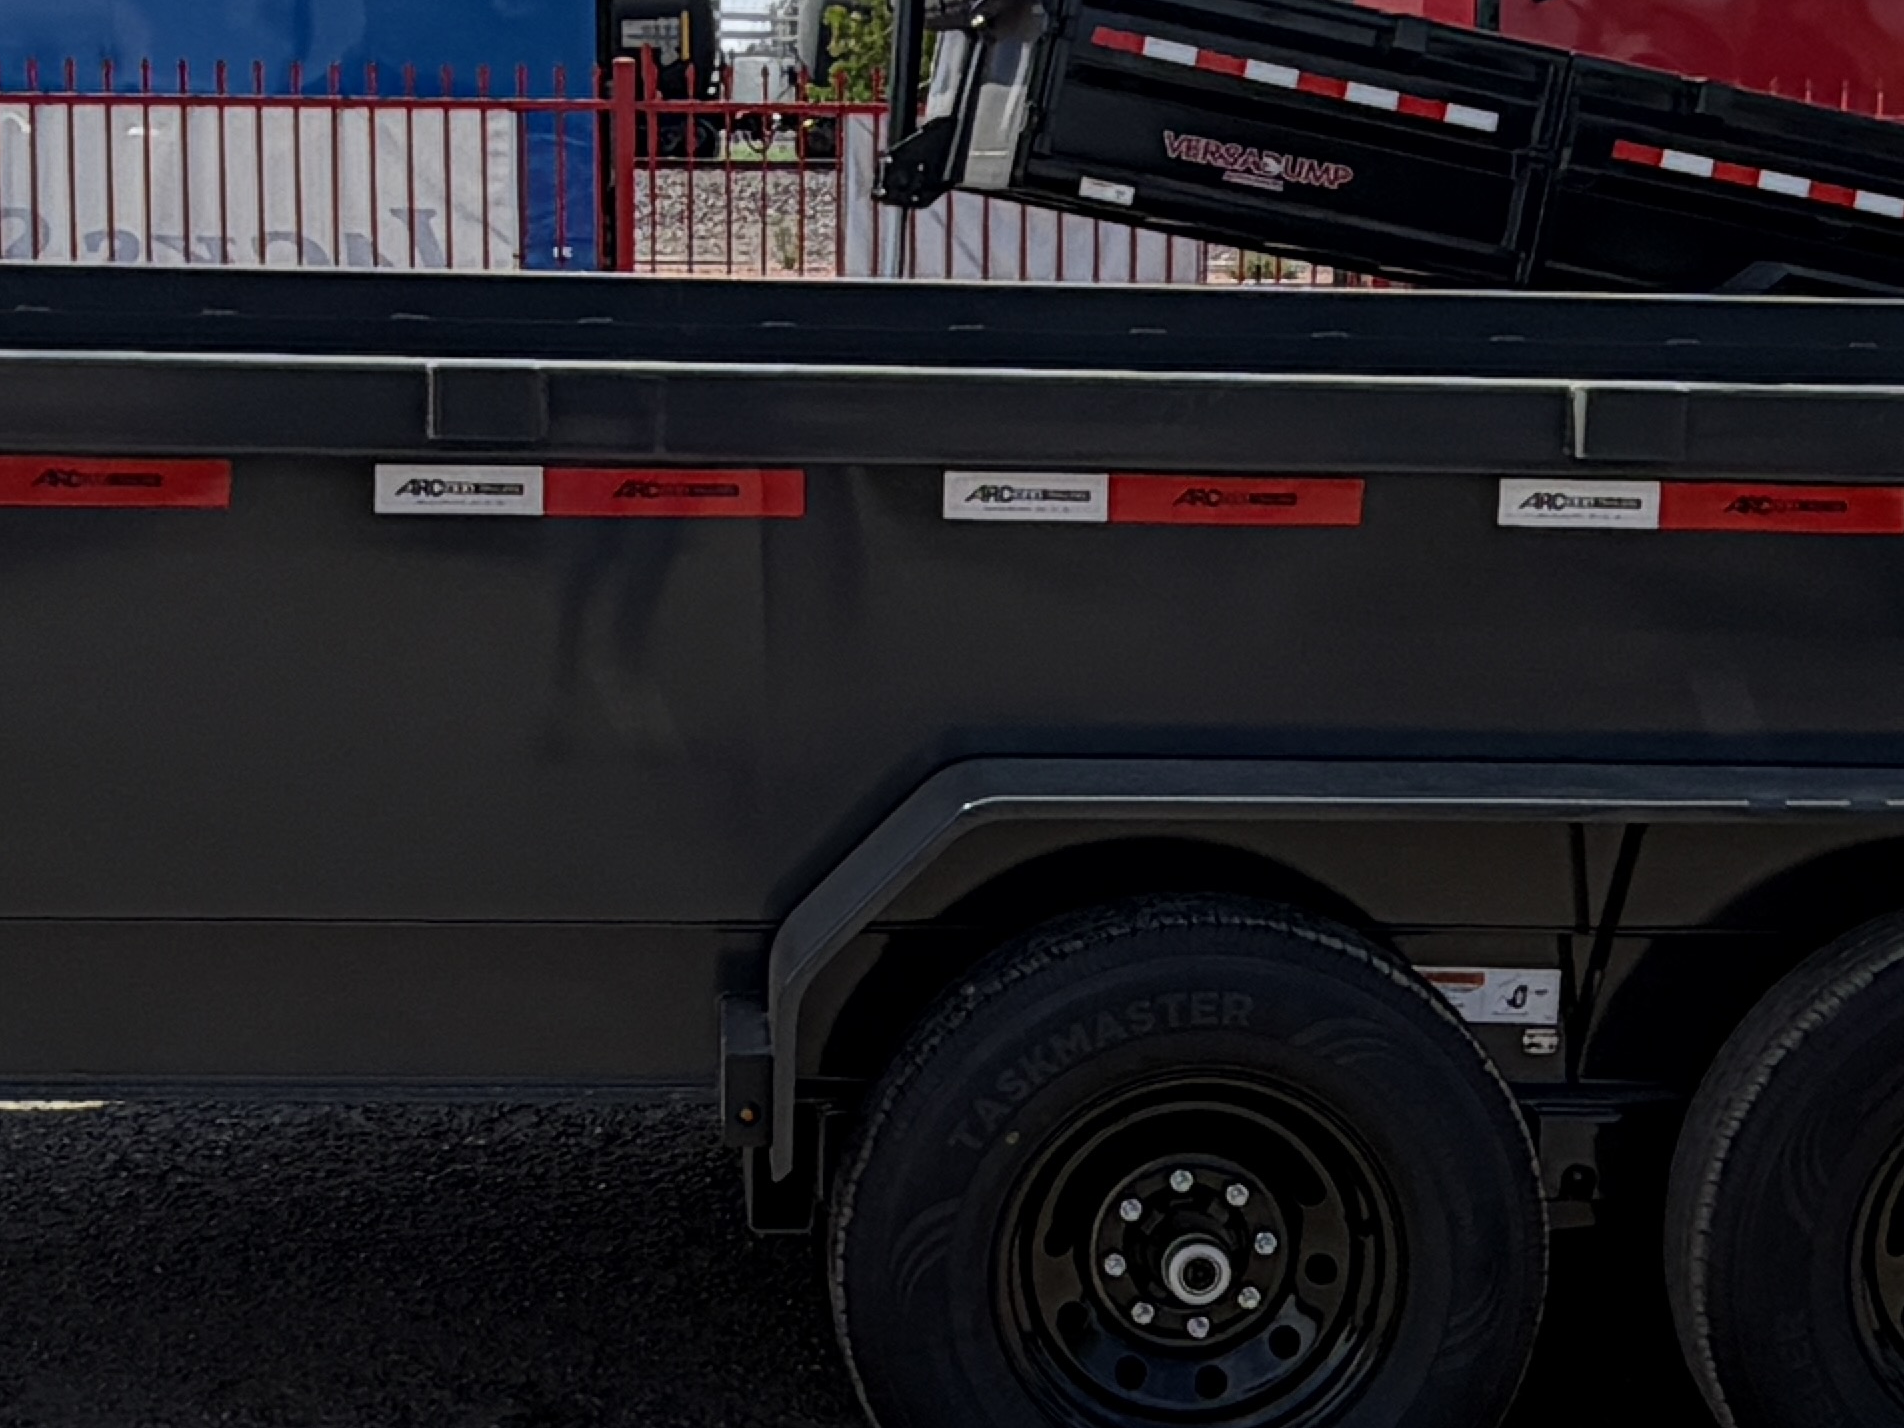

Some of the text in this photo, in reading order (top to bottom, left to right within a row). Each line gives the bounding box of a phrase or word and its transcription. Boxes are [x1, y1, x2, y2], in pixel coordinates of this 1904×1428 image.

[395, 478, 445, 498] ARC
[964, 484, 1014, 503] ARC
[1518, 492, 1567, 511] ARC
[949, 989, 1255, 1157] TASKMASTER
